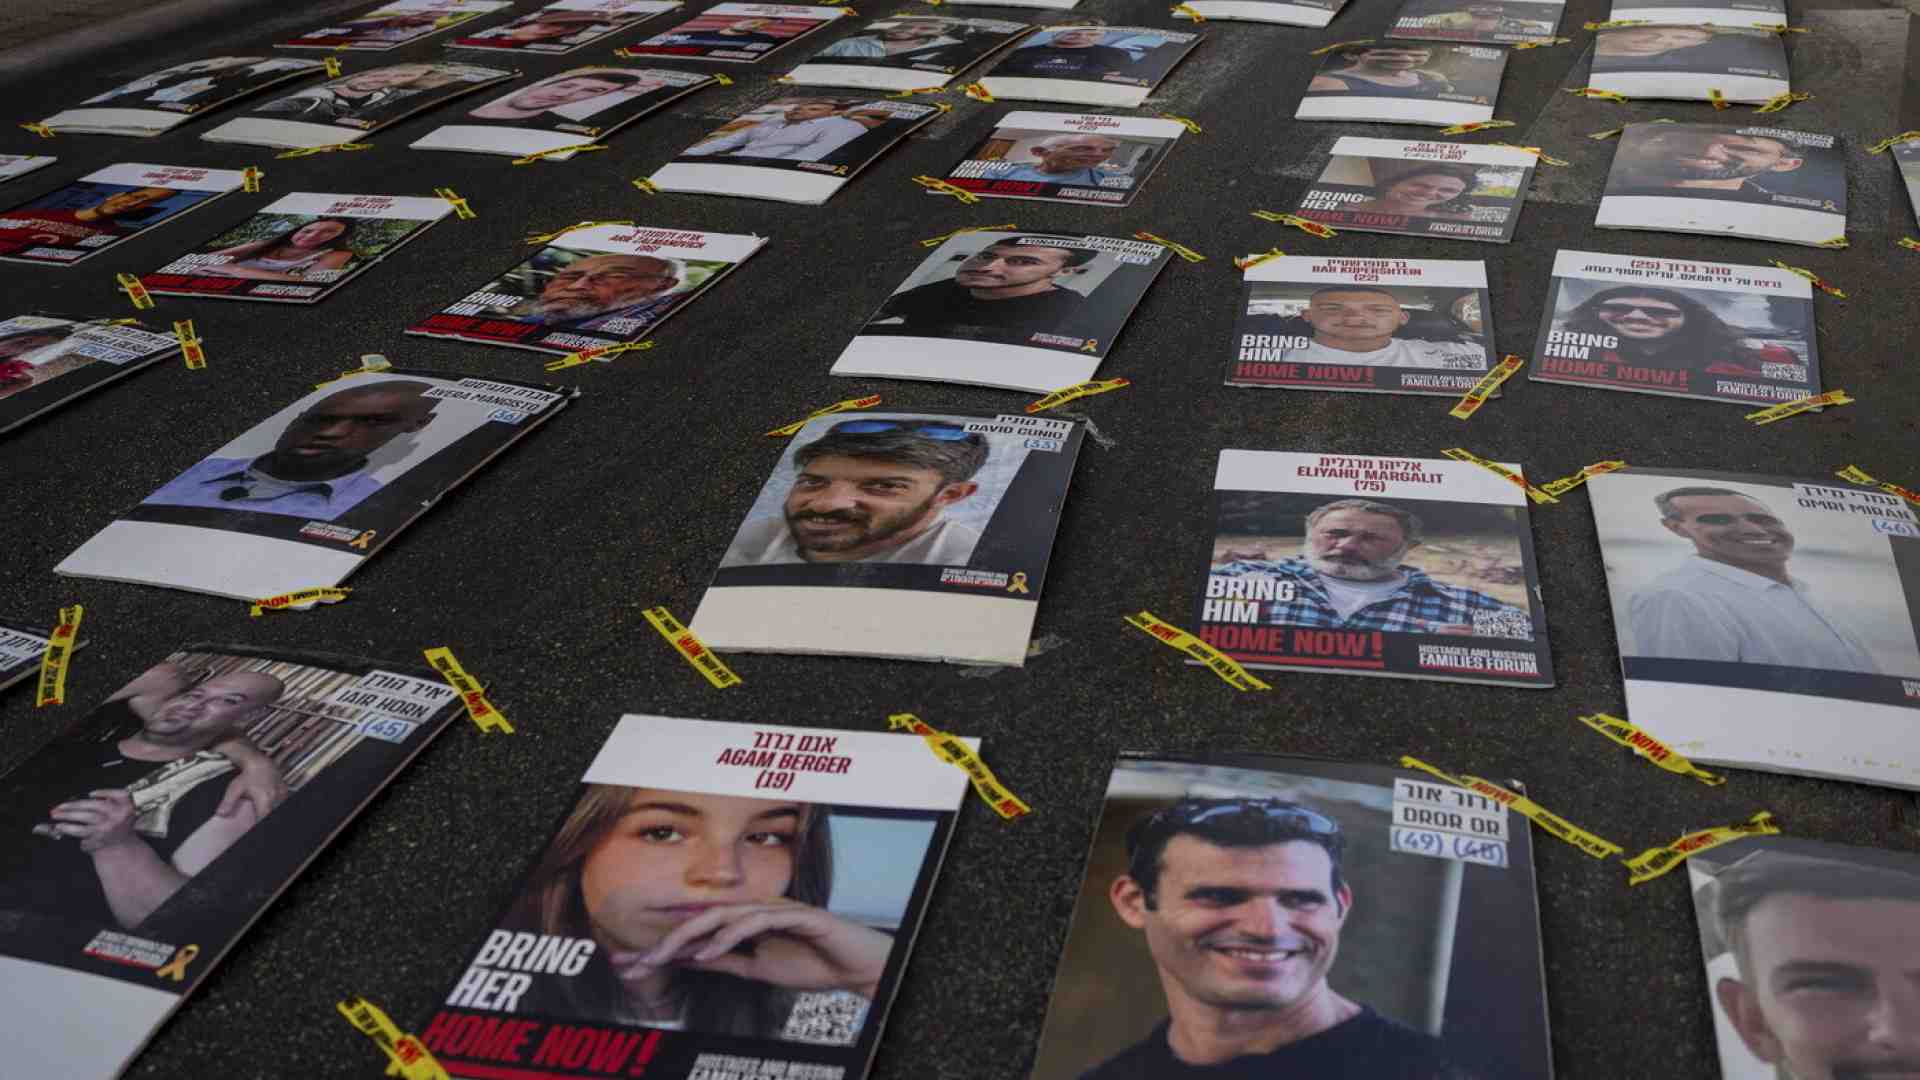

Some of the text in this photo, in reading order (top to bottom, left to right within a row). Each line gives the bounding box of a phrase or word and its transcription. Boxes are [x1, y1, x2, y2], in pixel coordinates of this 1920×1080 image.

[1300, 199, 1338, 210] HER
[1307, 190, 1364, 203] BRING
[1241, 334, 1308, 349] BRING
[1548, 330, 1618, 349] BRING
[1239, 348, 1281, 361] HIM
[1544, 343, 1589, 360] HIM
[1238, 362, 1374, 382] HOME NOW!
[1542, 360, 1688, 385] HOME NOW!
[968, 424, 1064, 439] DAVID CUNIO
[1297, 466, 1443, 484] ELIYAHU MARGALIT
[1354, 480, 1386, 492] (75)
[1798, 498, 1911, 520] OMRI MIRAN
[1205, 575, 1295, 602] BRING
[1202, 598, 1260, 624] HIM
[1200, 624, 1383, 657] HOME NOW!
[1418, 644, 1469, 657] HOSTAGES
[1470, 647, 1490, 658] AND
[1419, 653, 1538, 673] FAMILIES FORUM
[336, 691, 430, 718] IAIR HORN
[716, 748, 852, 774] AGAM BERGER
[754, 770, 796, 792] (19)
[1403, 807, 1500, 835] DROR OR
[1393, 831, 1443, 855] (49)
[473, 928, 596, 977] BRING
[445, 965, 533, 1013] HER
[420, 1011, 539, 1062] HOME
[532, 1023, 663, 1077] NOW!
